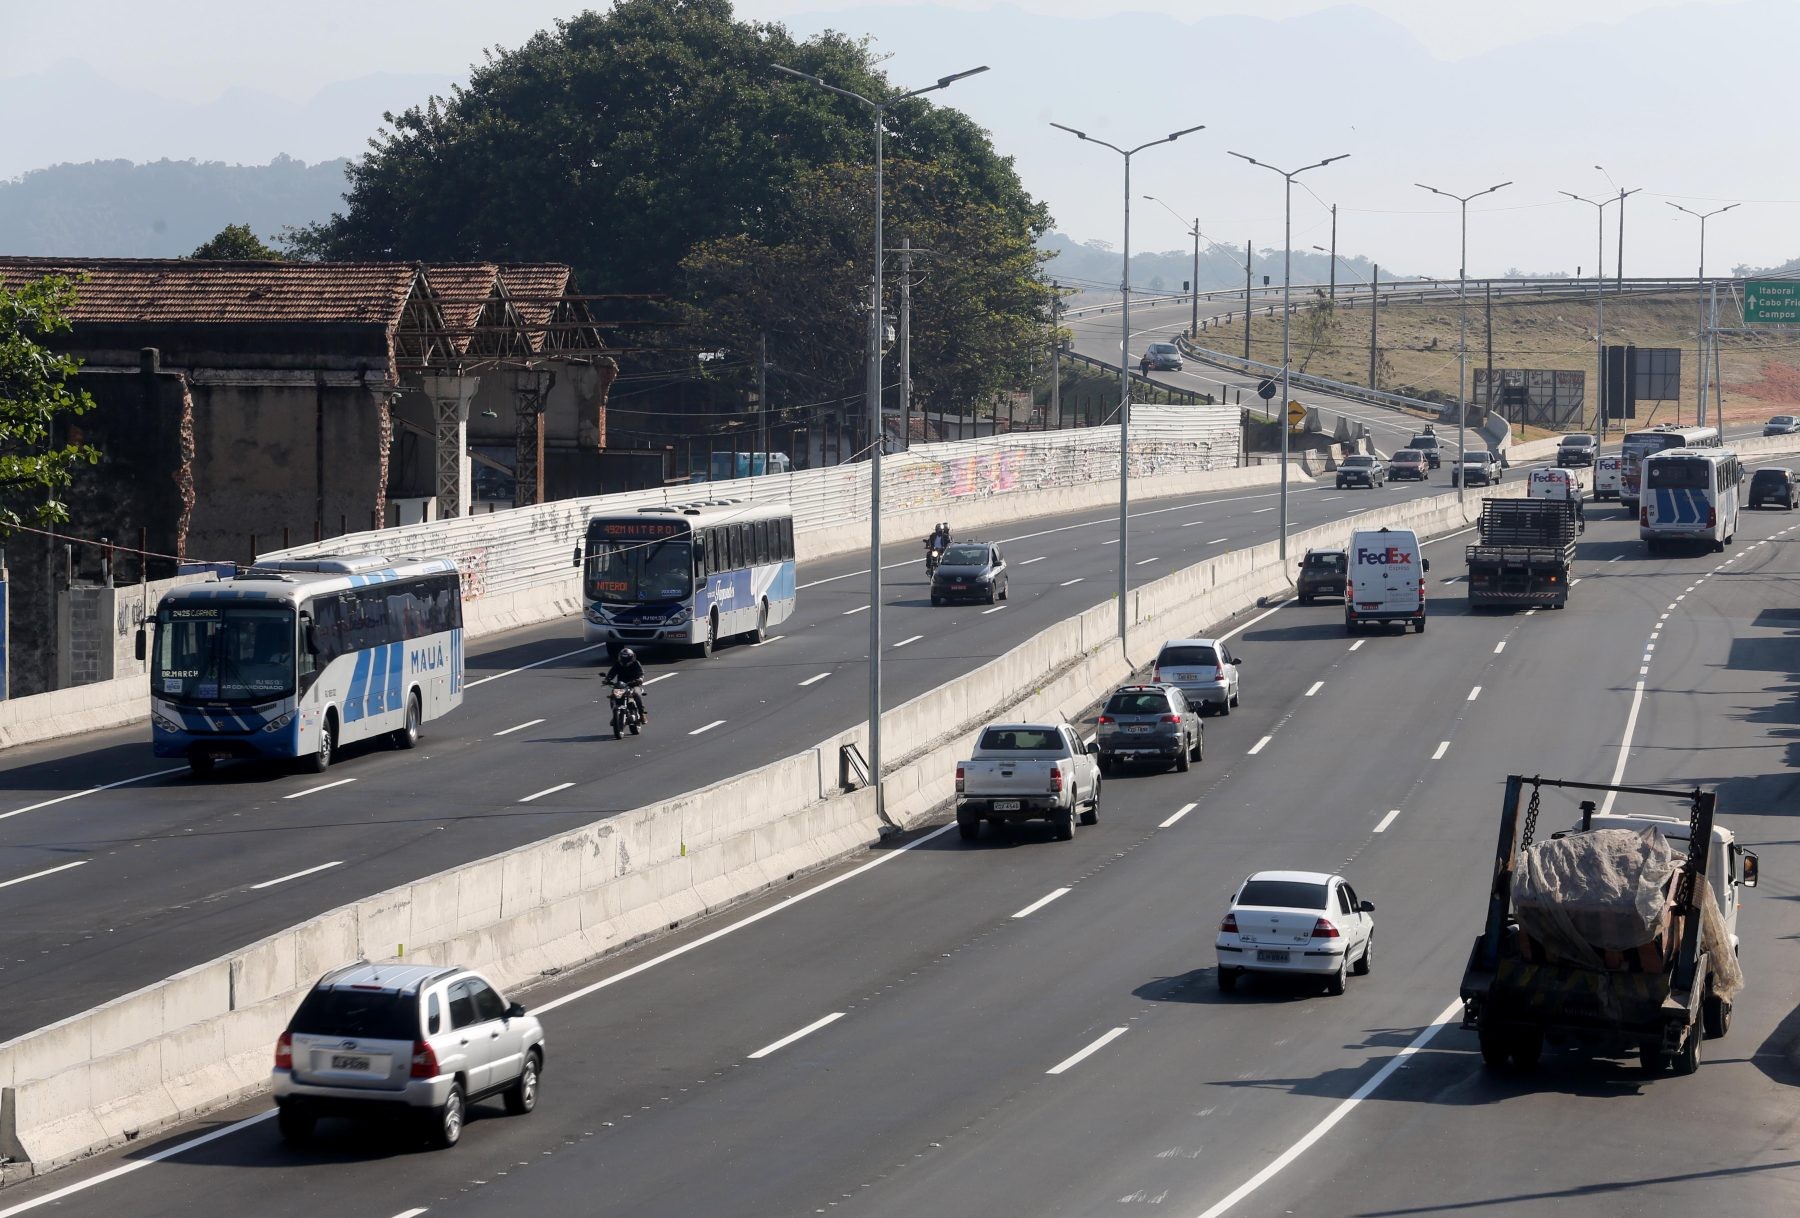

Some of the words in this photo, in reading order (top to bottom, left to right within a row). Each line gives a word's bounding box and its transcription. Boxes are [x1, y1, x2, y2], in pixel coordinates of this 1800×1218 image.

[1760, 287, 1794, 295] Itaboraí
[1759, 311, 1796, 320] Campos
[1600, 461, 1621, 471] FedE
[1533, 473, 1563, 483] FedEx
[1358, 547, 1412, 565] FedEx
[411, 641, 444, 674] MAUÁ
